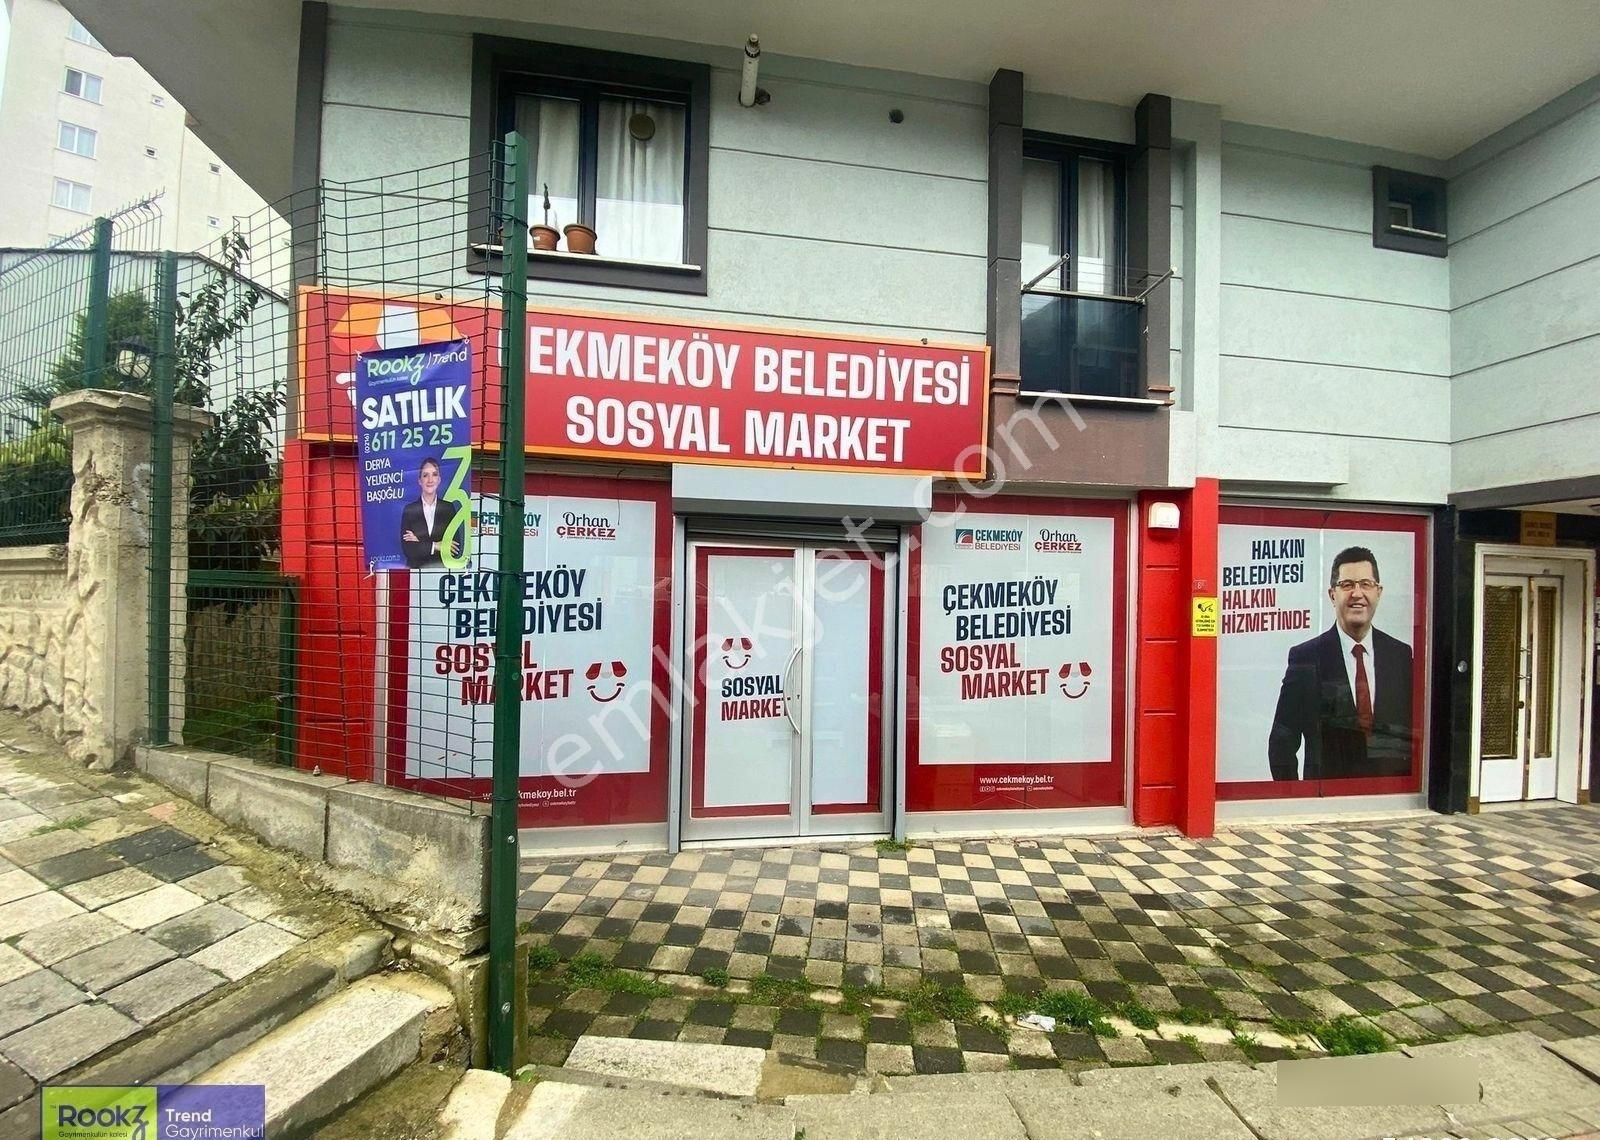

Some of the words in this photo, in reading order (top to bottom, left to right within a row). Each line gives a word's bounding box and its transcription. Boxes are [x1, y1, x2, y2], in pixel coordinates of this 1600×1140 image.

[432, 347, 468, 369] Trend
[498, 326, 740, 390] EKMEKÖY
[754, 346, 971, 406] BELEDİYESİ
[362, 385, 467, 430] SATILIK
[372, 430, 396, 451] 611
[402, 427, 424, 449] 25
[429, 424, 453, 446] 25
[566, 395, 731, 453] SOSYAL
[745, 409, 911, 463] MARKET
[365, 457, 391, 471] DERYA
[366, 470, 404, 486] YELKENCİ
[366, 486, 405, 503] BAŞOĞLU
[563, 512, 611, 527] Orhan
[556, 526, 616, 539] ÇERKEZ
[975, 529, 1023, 543] ÇEKMEKÖY
[1040, 529, 1079, 543] Orhan
[1034, 541, 1082, 553] ÇERKEZ
[1252, 539, 1305, 560] HALKIN
[1222, 561, 1304, 586] BELEDİYESİ
[439, 565, 586, 609] ÇEKEKÖY
[943, 576, 1059, 616] ÇEKMEKÖY
[1222, 588, 1276, 610] HALKIN
[455, 597, 603, 639] BELDİYESİ
[956, 605, 1072, 642] BELEDİYESİ
[1221, 609, 1311, 634] HİZMETİNDE
[941, 642, 1021, 673] SOSYAL
[721, 674, 784, 698] SOSYAL
[961, 668, 1050, 701] MARKET
[980, 774, 1054, 785] www.cekmekoy.bel.tr
